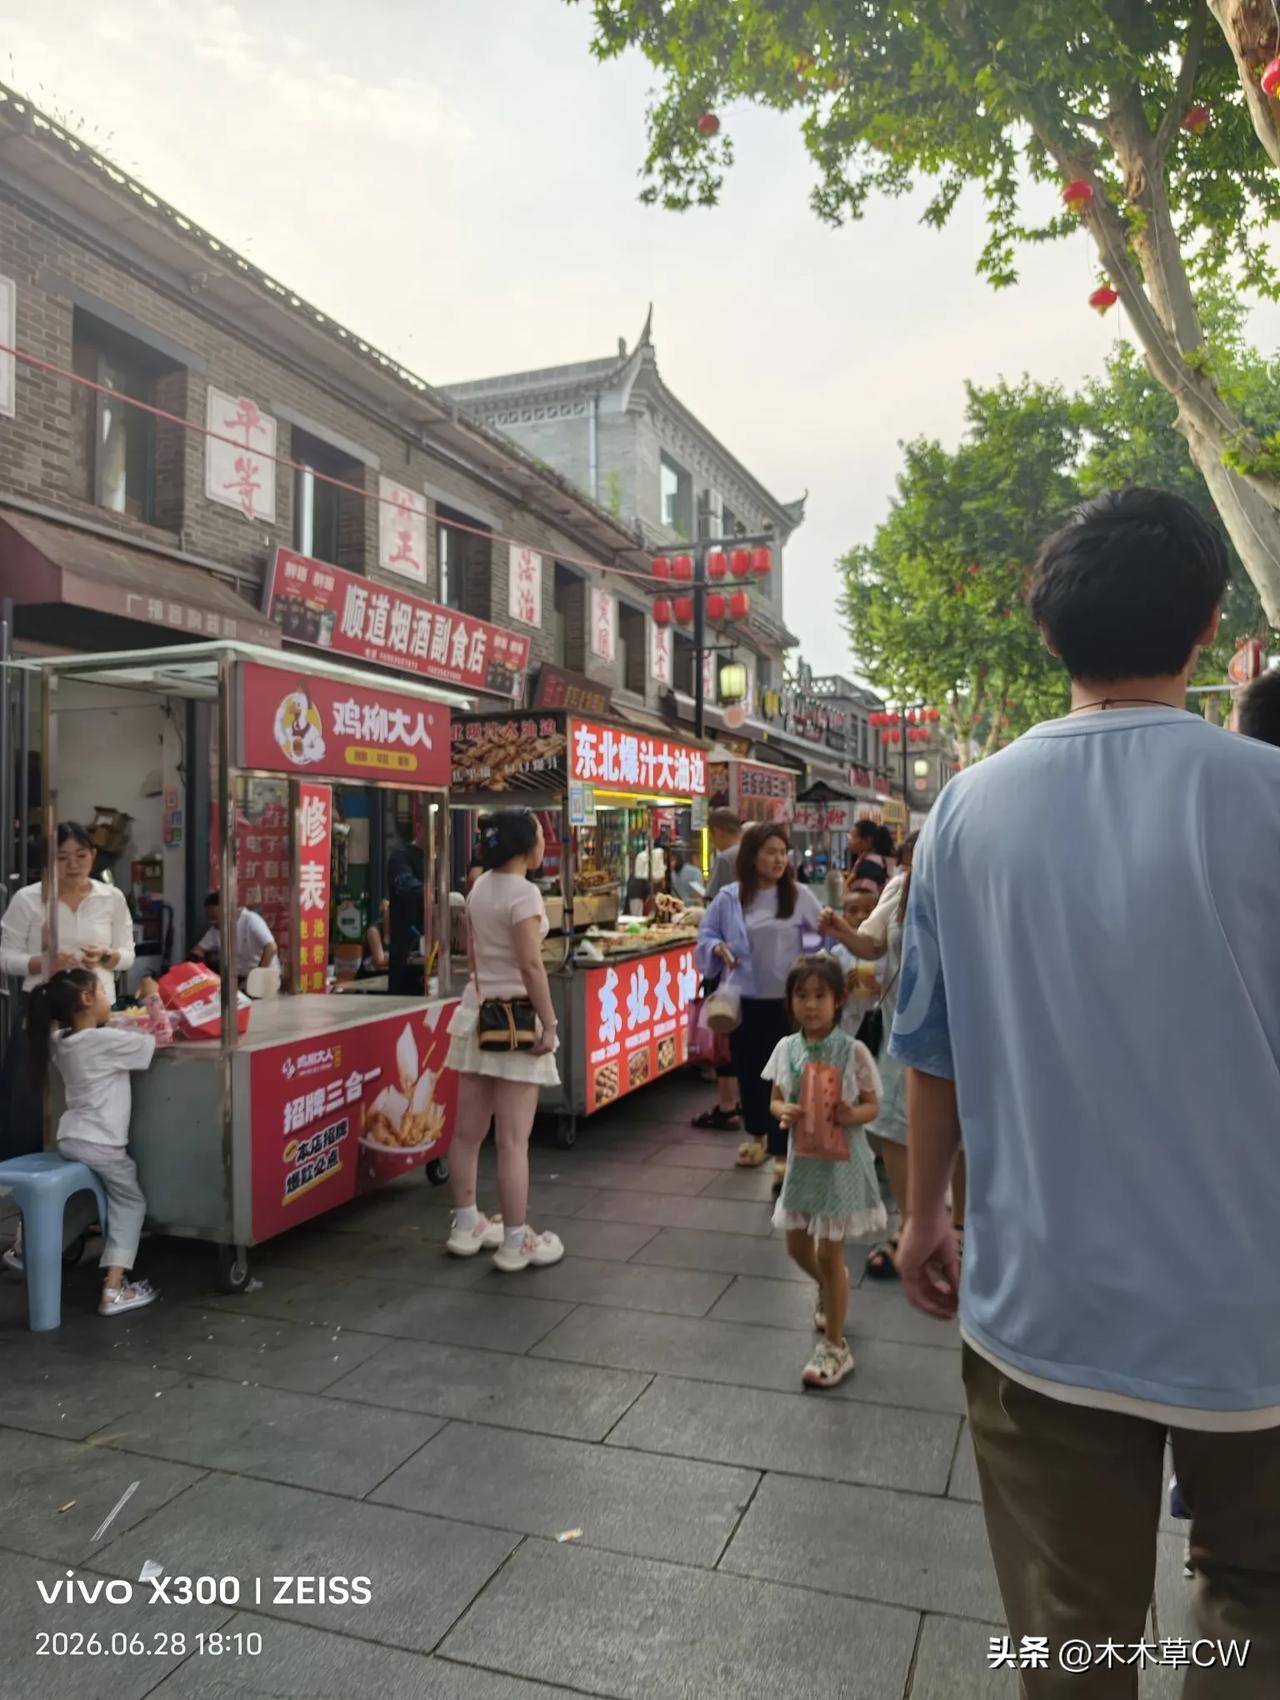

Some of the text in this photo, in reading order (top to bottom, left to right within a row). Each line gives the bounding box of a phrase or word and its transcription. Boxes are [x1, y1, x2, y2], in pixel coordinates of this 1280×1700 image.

[223, 397, 266, 521] 平等
[340, 583, 488, 674] 顺道烟酒副食店
[332, 698, 433, 750] 鸡柳大人
[574, 724, 706, 793] 东北爆汁大油边
[298, 796, 327, 911] 修表
[598, 951, 704, 1043] 东北大油
[284, 1067, 382, 1135] 招牌三合一
